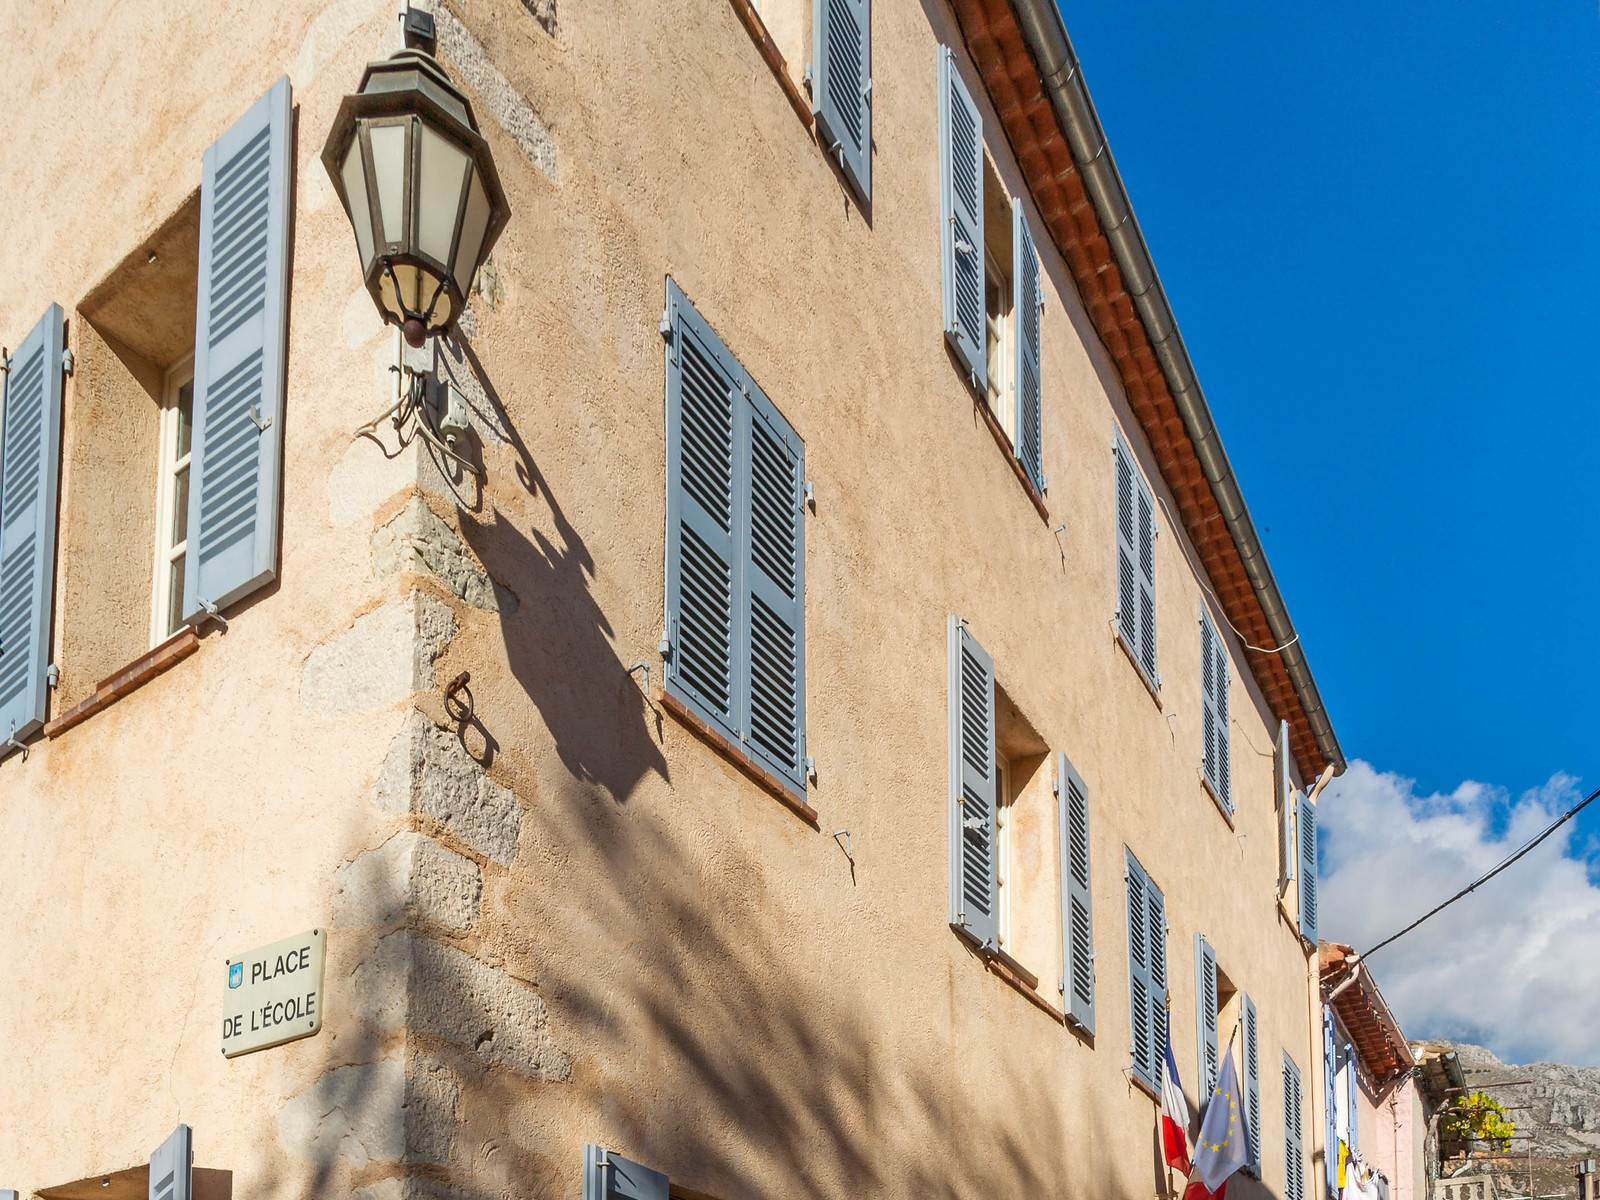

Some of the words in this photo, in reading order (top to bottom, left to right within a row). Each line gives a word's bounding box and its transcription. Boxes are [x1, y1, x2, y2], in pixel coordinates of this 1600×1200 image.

[251, 945, 311, 985] PLACE
[223, 1014, 243, 1040] DE
[251, 991, 316, 1032] L'ÉCOLE
